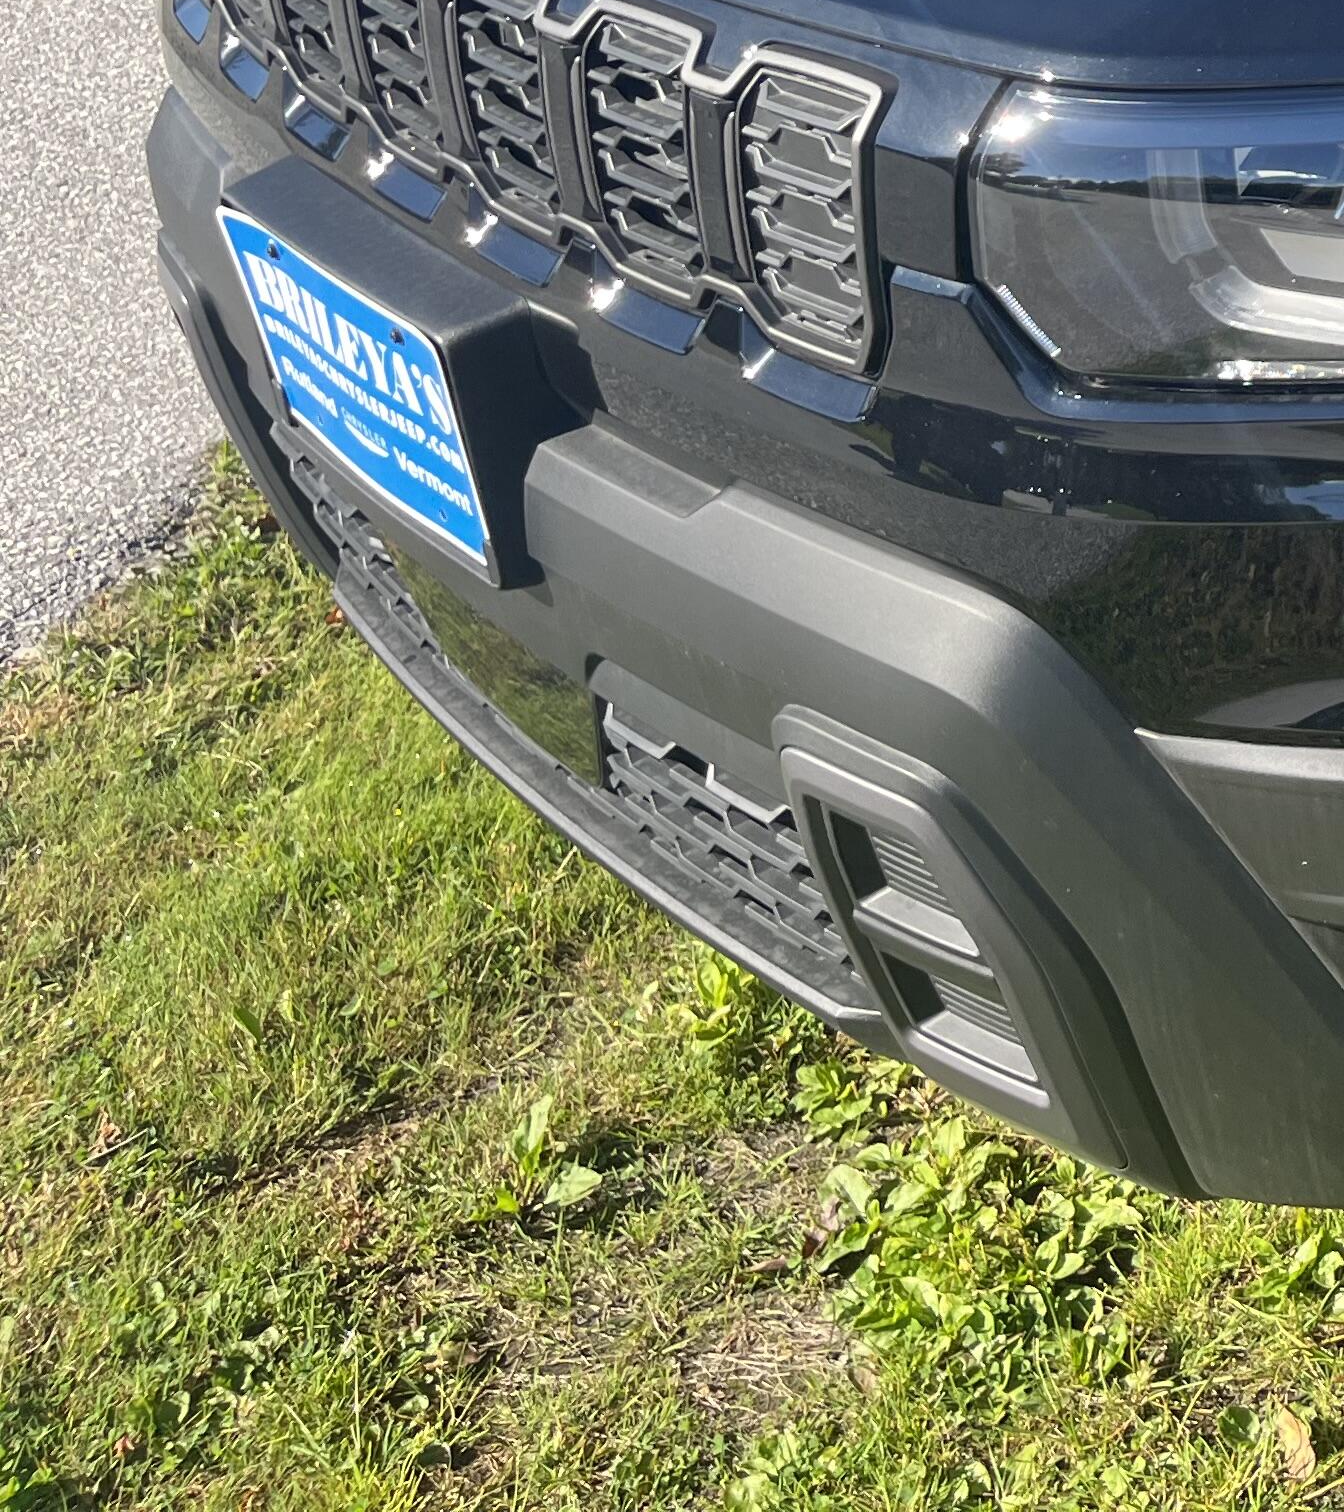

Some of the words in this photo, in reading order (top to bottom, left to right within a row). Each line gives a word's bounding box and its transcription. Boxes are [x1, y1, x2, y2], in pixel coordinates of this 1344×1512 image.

[242, 249, 453, 436] BRILEYA'S
[281, 354, 339, 419] Rutland
[392, 445, 474, 517] Vermont
